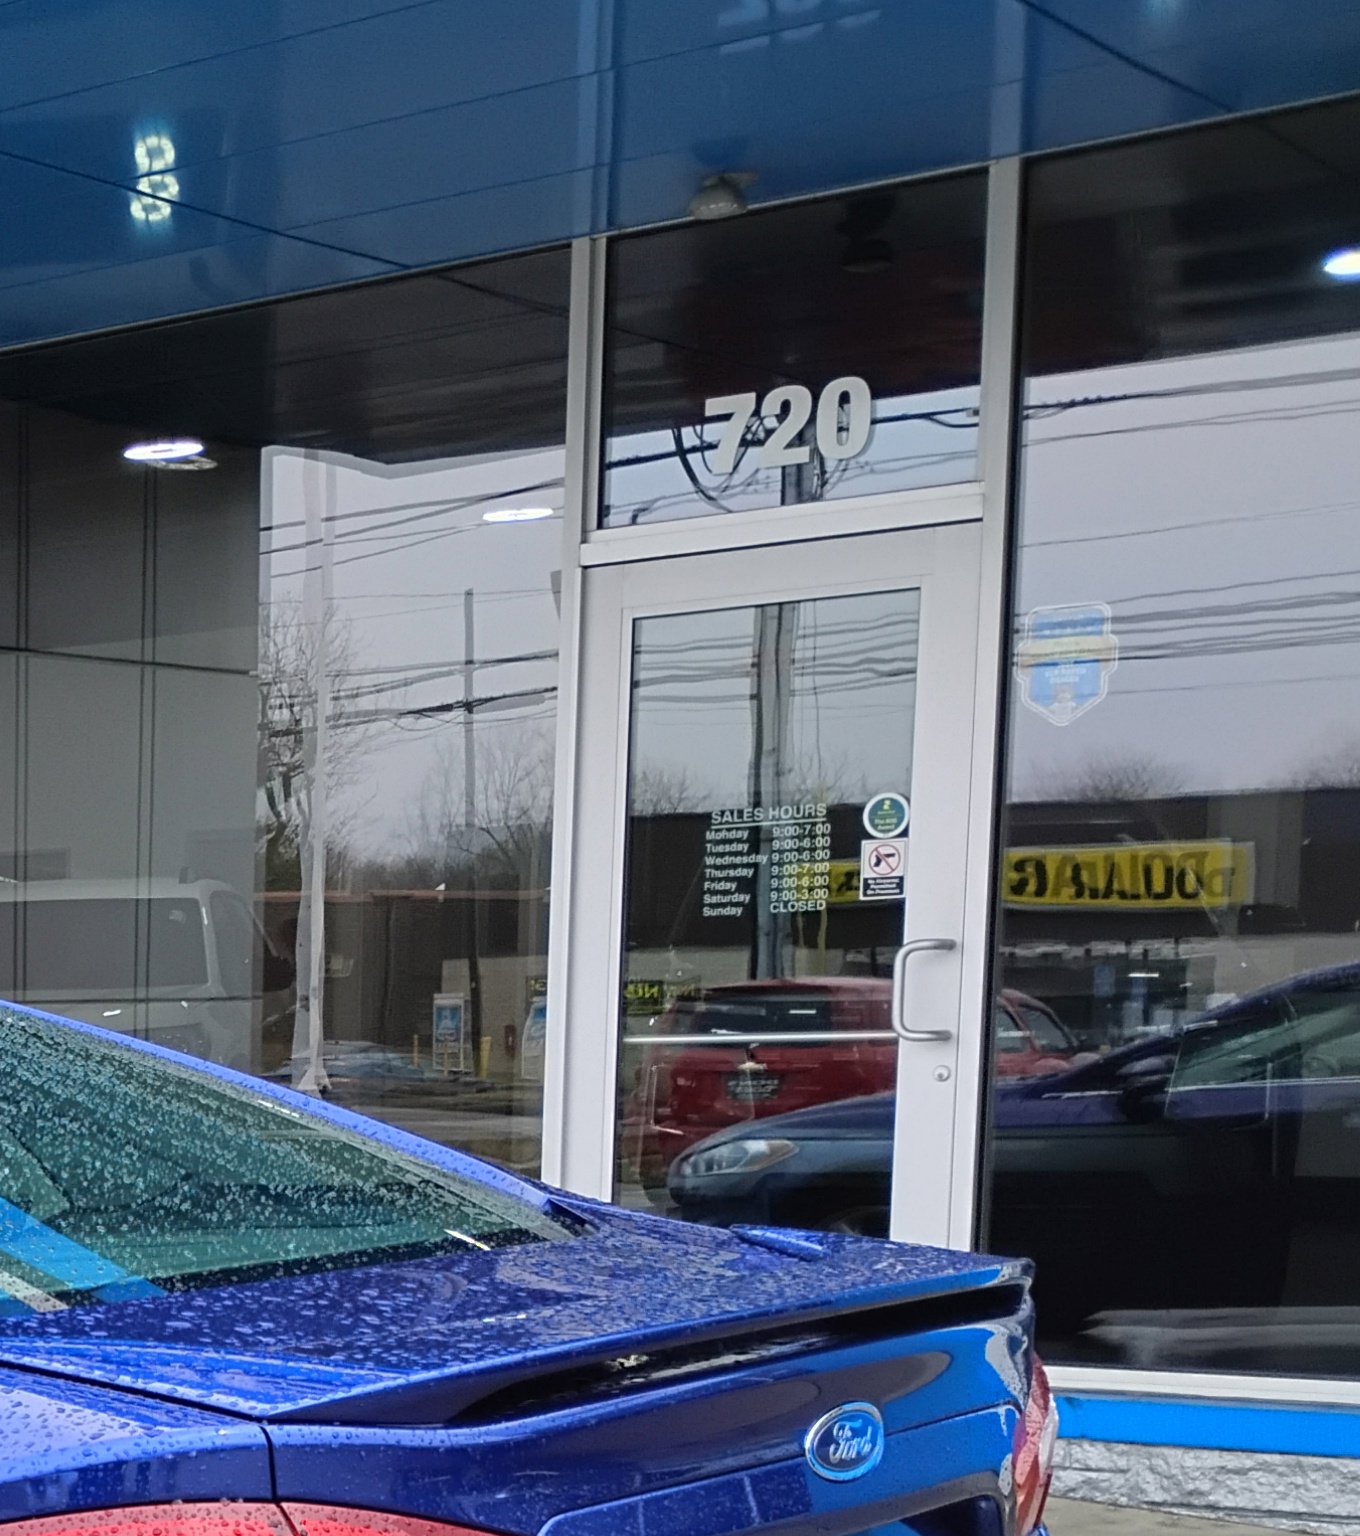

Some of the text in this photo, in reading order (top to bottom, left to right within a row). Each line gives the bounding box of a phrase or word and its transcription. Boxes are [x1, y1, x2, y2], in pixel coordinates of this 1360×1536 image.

[704, 375, 872, 475] 720
[711, 803, 827, 824] SALES HOURS
[706, 824, 831, 840] Monday 9:00-7:00
[705, 836, 831, 853] Tuesday 9:00-6:00
[705, 850, 830, 865] Wednesday 9:00-6:00
[704, 862, 830, 878] Thursday 9:00-7:00
[704, 875, 829, 892] Friday 9:00-6:00
[703, 888, 829, 904] Saturday 9:00-3:00
[703, 900, 826, 917] Sunday CLOSED
[829, 1419, 872, 1464] Ford
